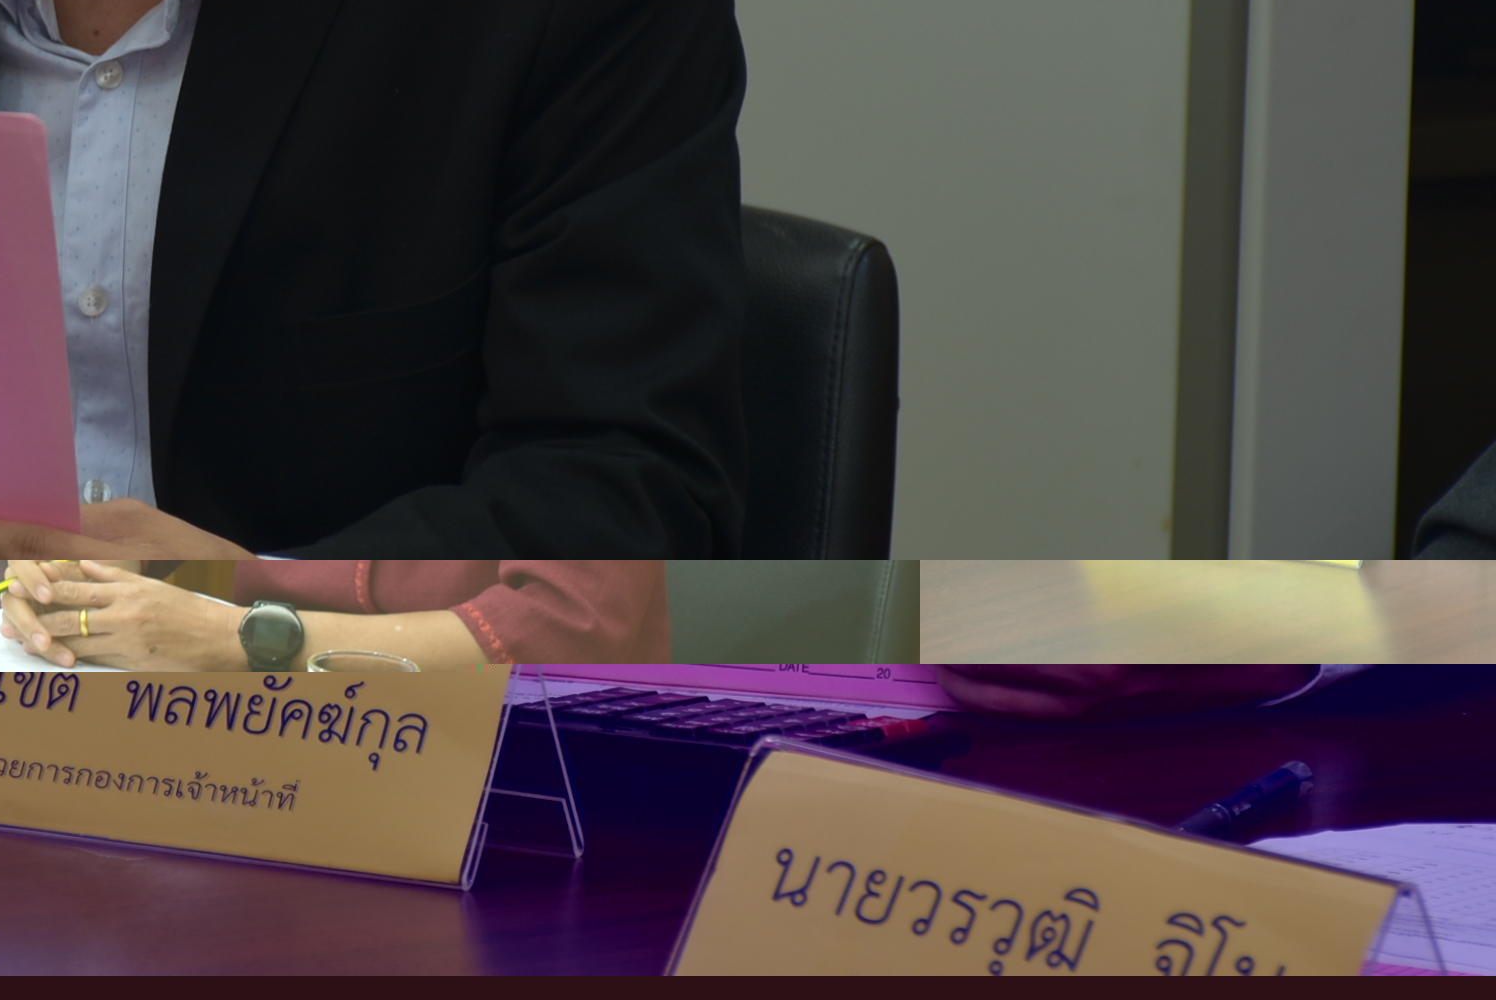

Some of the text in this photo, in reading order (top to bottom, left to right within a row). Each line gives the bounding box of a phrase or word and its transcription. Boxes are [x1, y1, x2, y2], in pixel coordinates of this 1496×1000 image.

[778, 664, 892, 680] DATE 20
[126, 674, 429, 772] พลพยัคฆ์กุล
